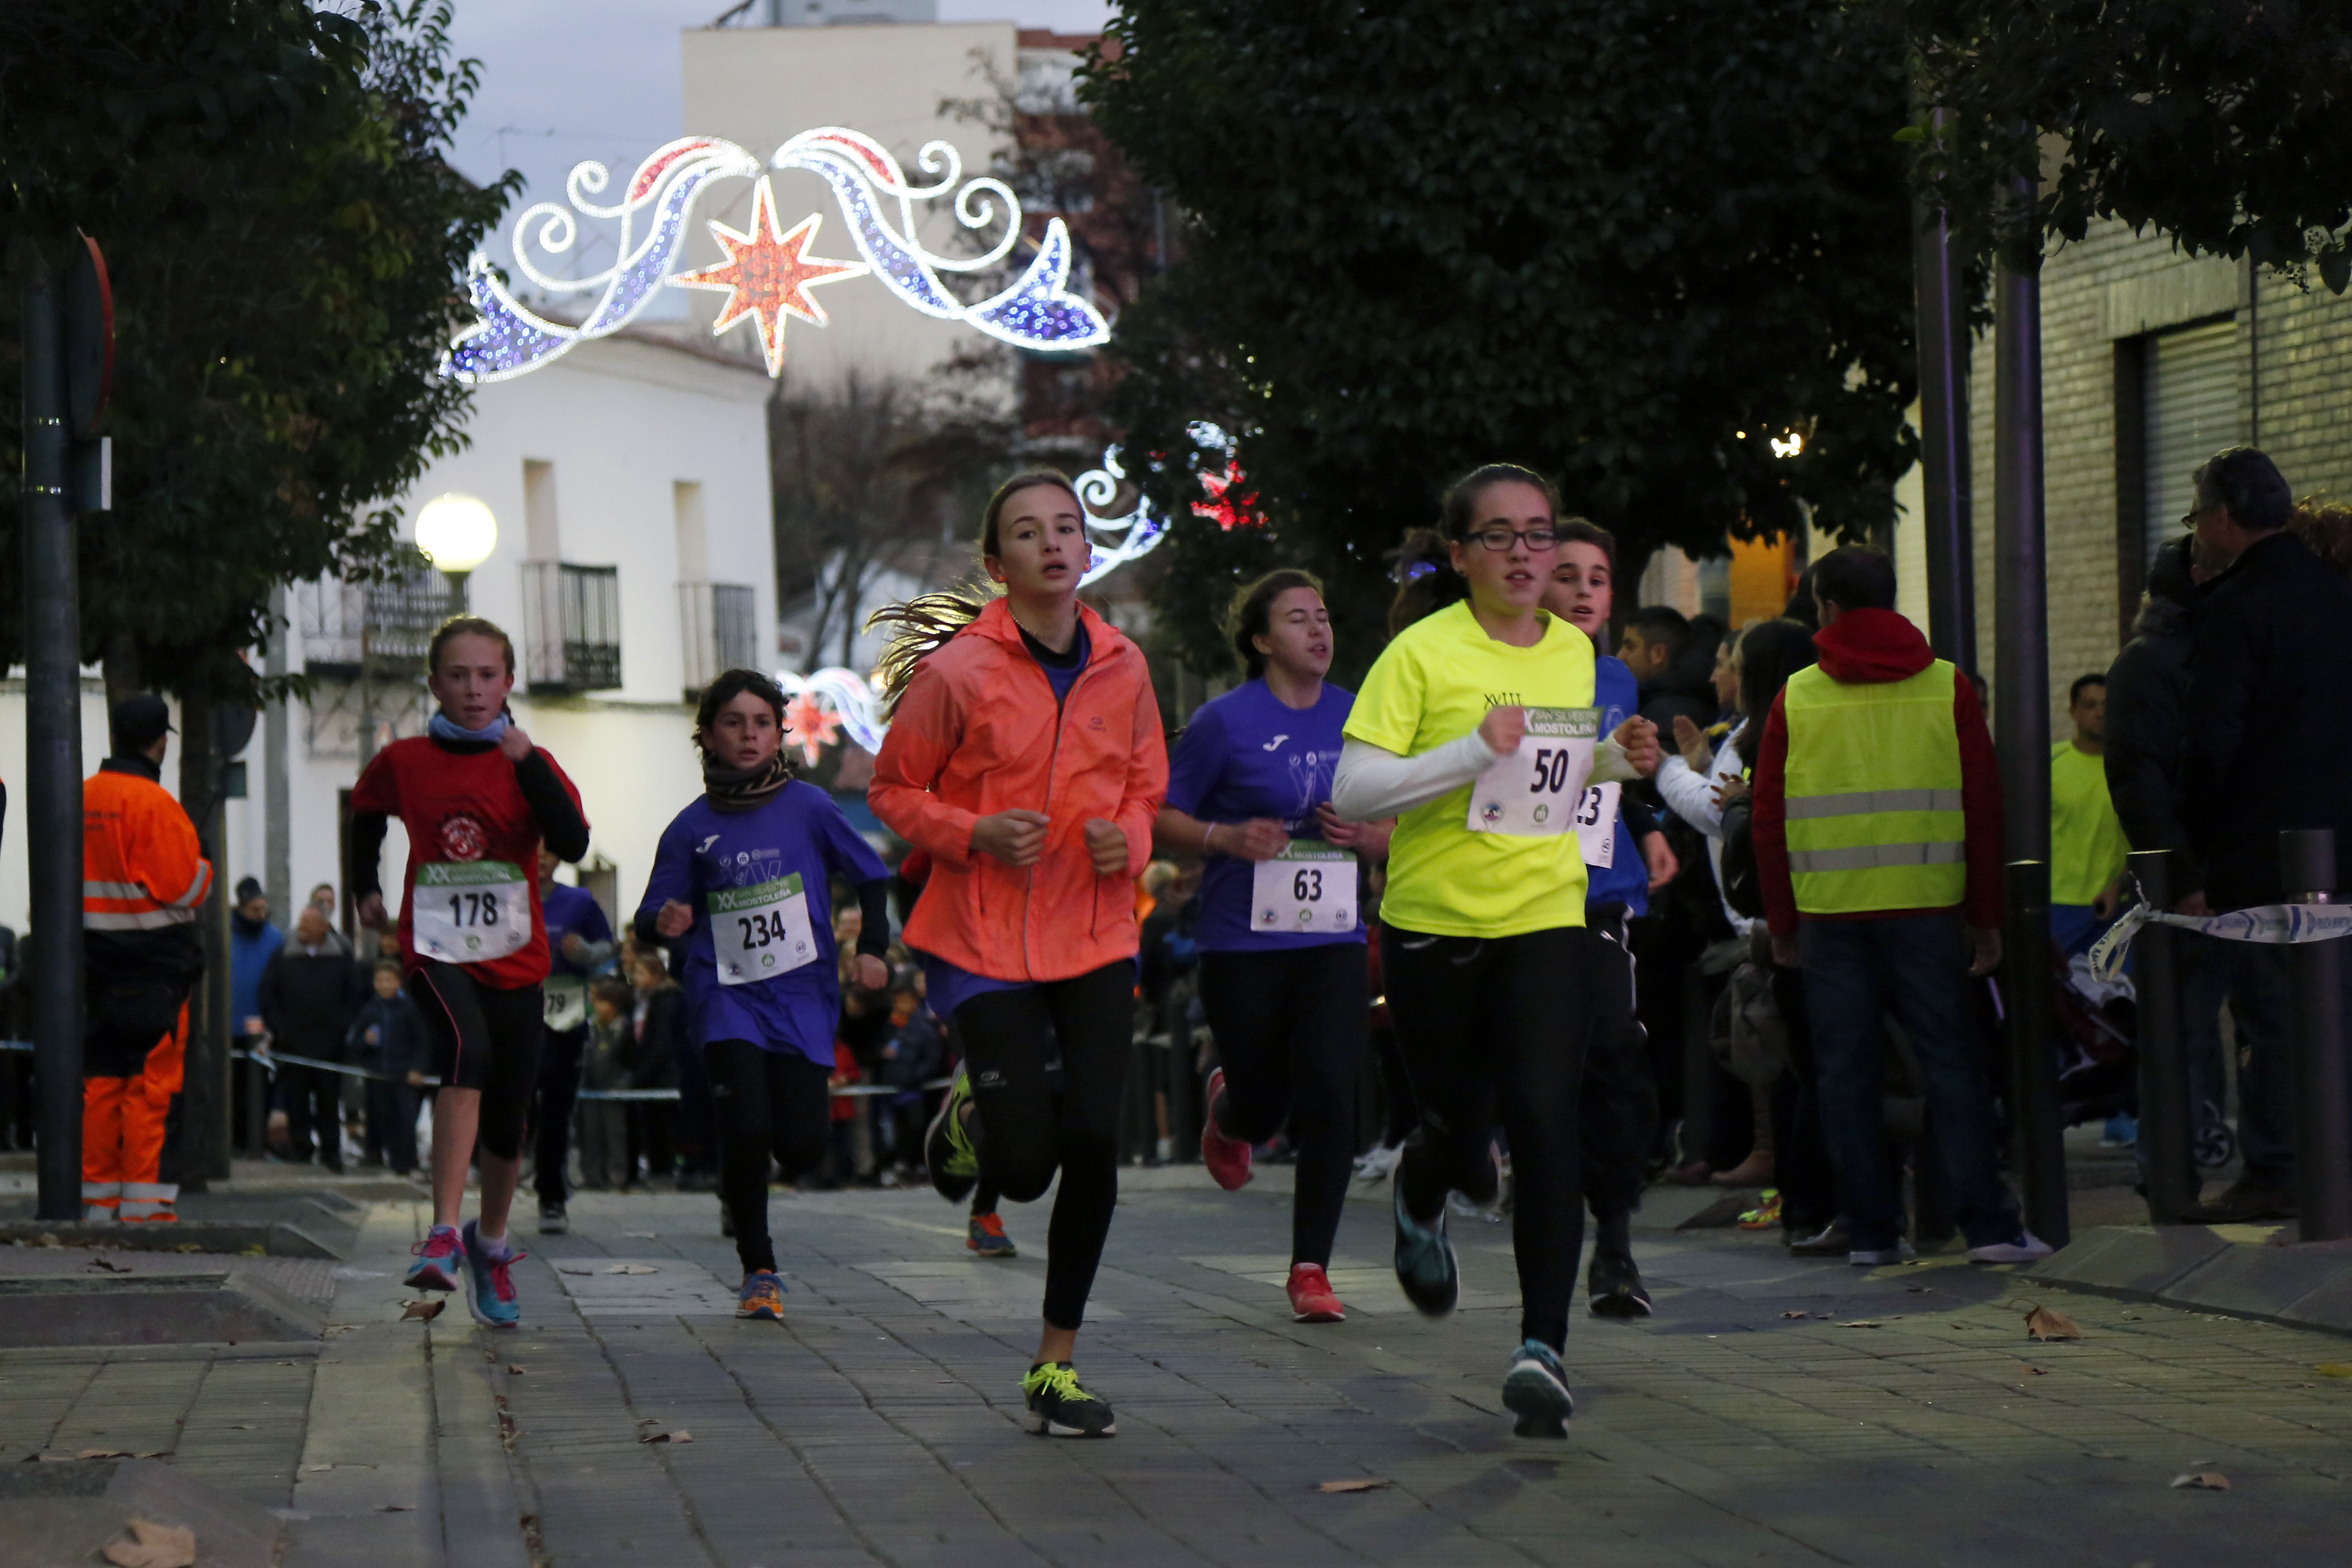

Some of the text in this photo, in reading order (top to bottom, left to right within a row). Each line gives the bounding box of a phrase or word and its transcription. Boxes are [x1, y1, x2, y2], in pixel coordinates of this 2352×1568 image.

[1530, 748, 1569, 794] 50
[426, 863, 450, 884] XX
[1293, 869, 1322, 901] 63
[449, 891, 498, 928] 178
[717, 891, 739, 911] XX
[738, 910, 786, 951] 234
